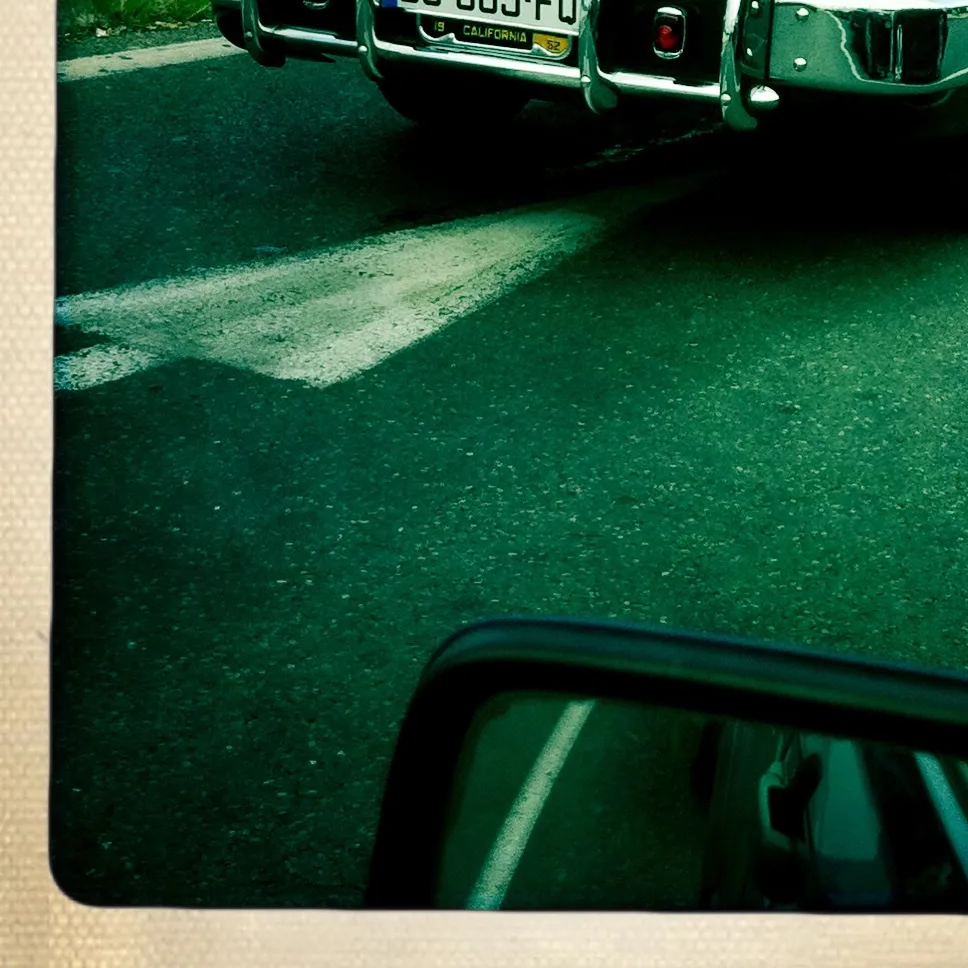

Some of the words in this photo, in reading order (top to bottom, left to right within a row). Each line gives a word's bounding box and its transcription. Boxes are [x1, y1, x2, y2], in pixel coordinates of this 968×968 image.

[434, 21, 445, 32] 19
[463, 24, 528, 44] CALIFORNIA
[546, 39, 561, 51] 52
